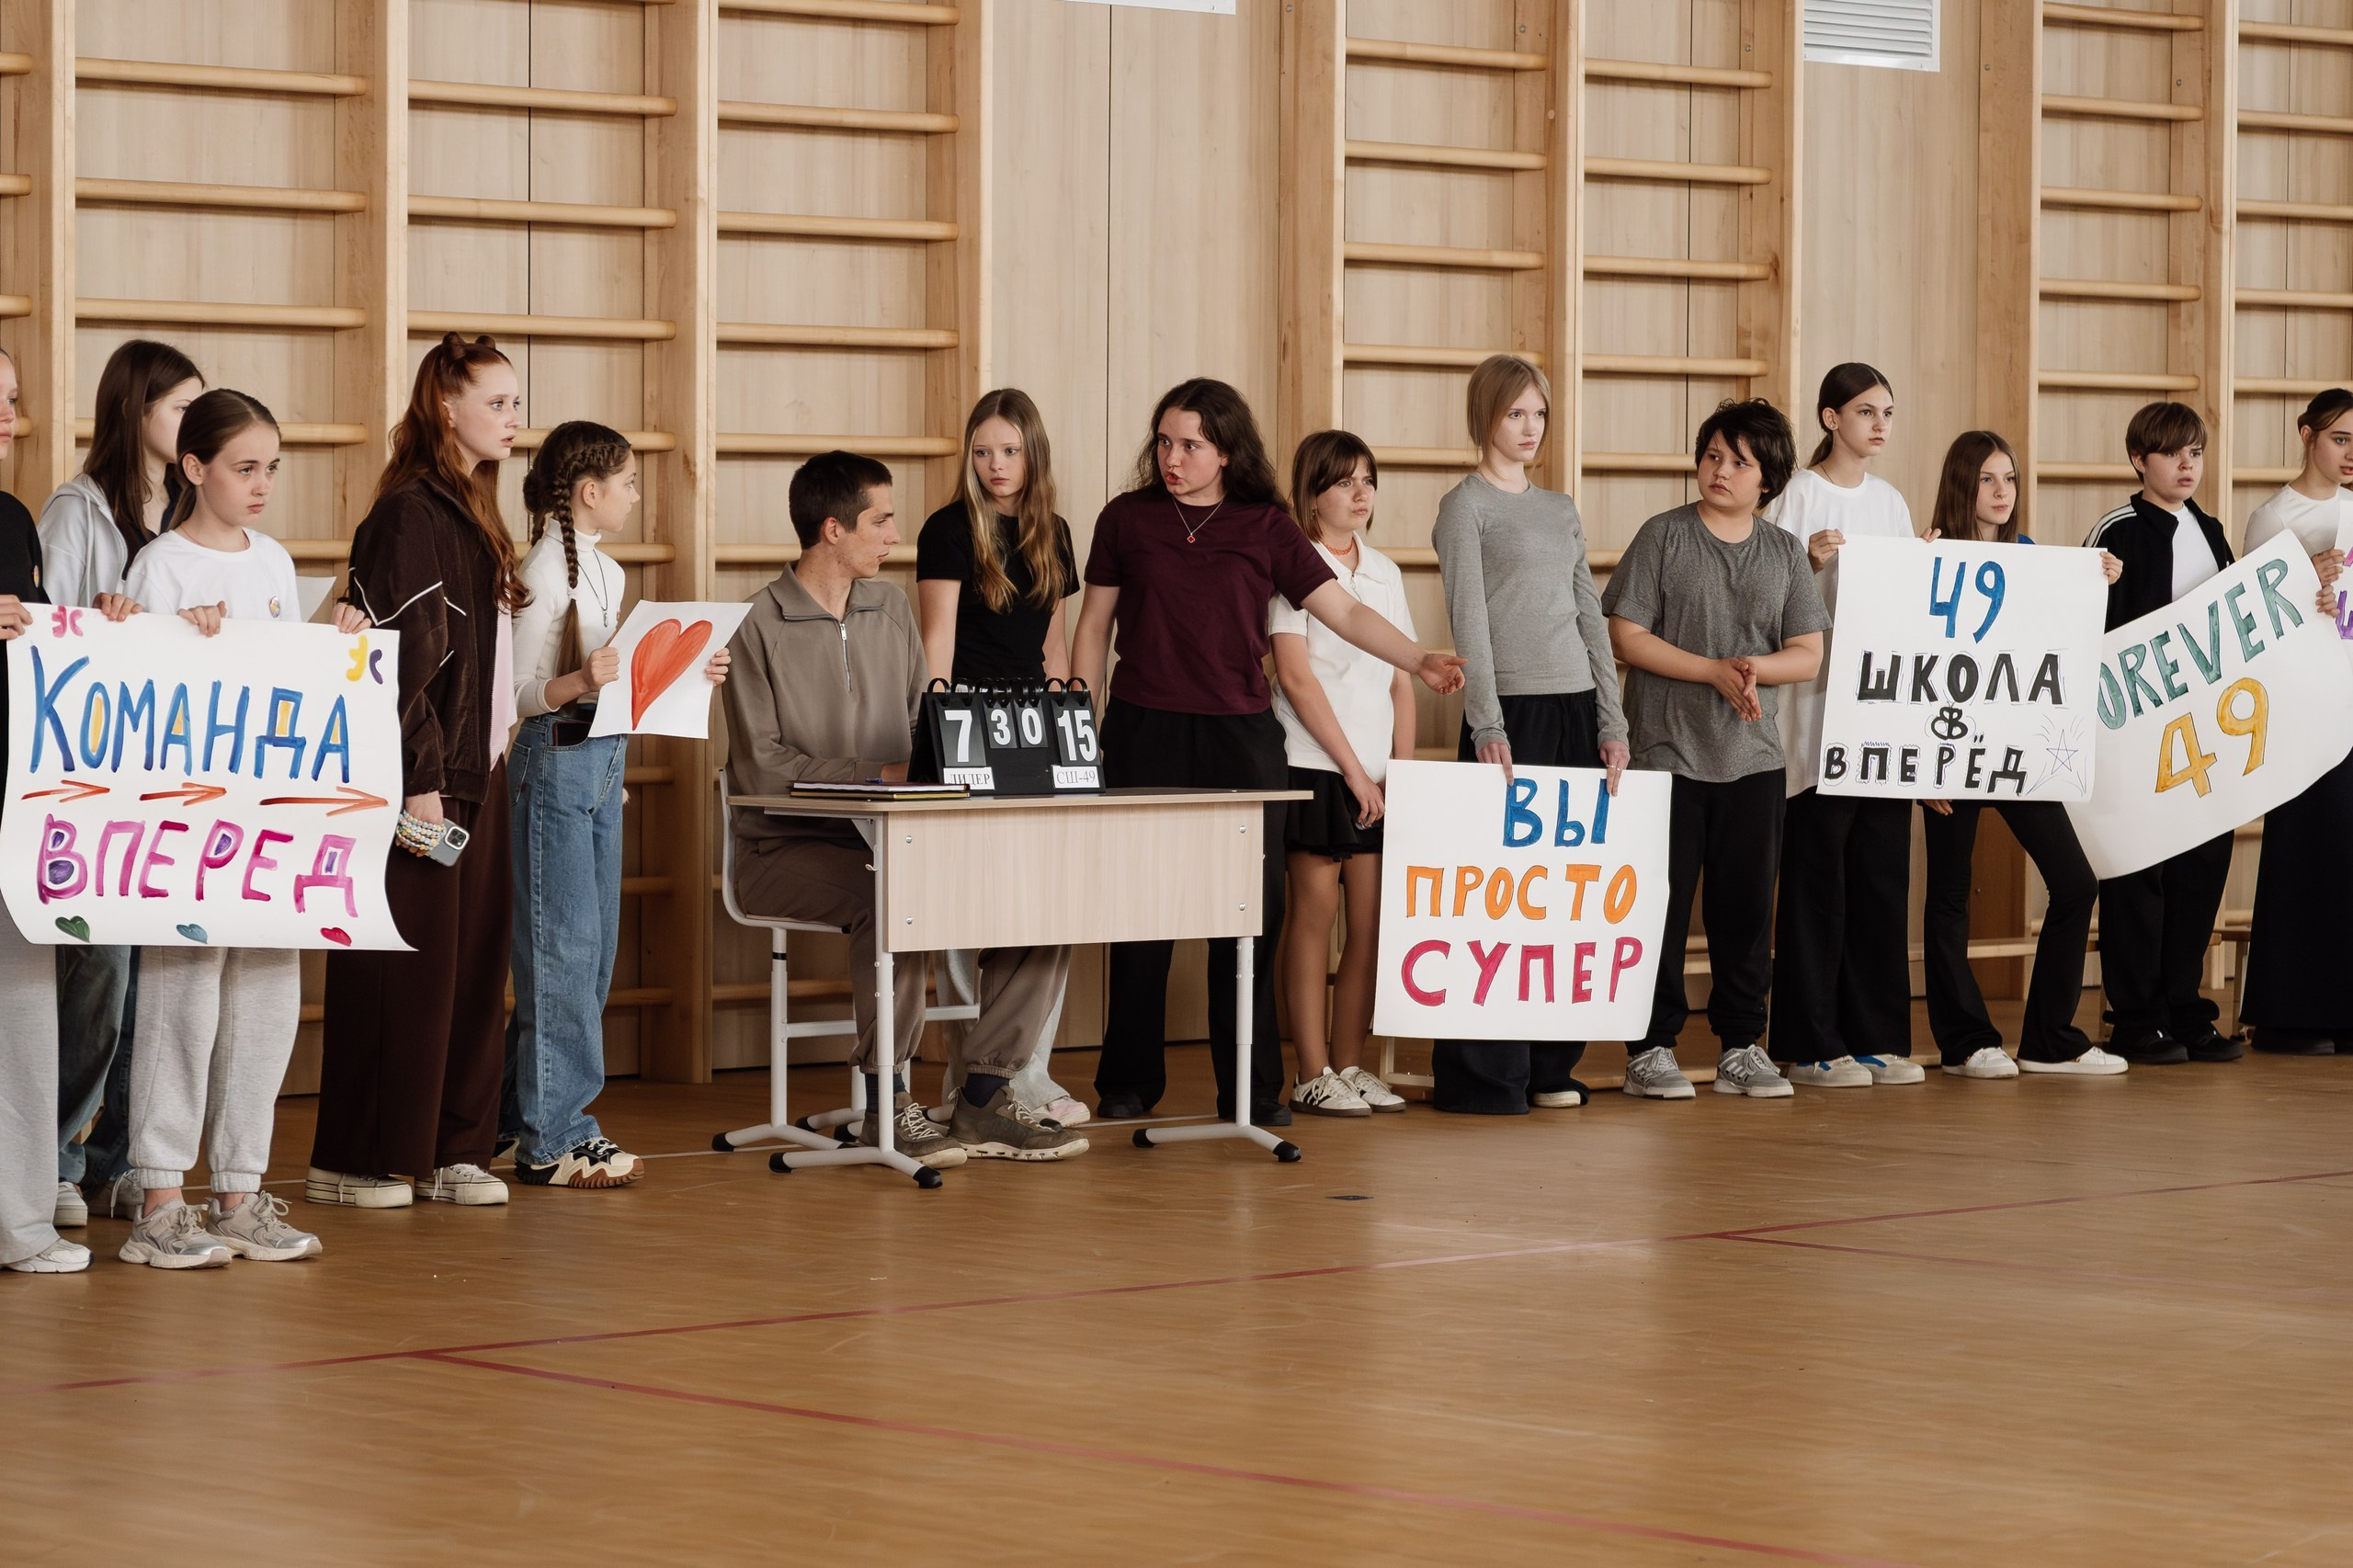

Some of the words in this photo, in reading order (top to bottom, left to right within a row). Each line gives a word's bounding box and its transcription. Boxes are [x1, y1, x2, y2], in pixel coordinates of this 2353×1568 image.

[1929, 557, 2006, 643] 49
[1856, 650, 2065, 706] ШКОЛА
[2097, 559, 2304, 730] OREVER
[29, 644, 350, 784] КОМАНДА
[944, 710, 972, 763] 7
[1057, 710, 1097, 762] 15
[2154, 677, 2269, 799] 49
[949, 773, 991, 786] ЛИДЕР
[1056, 769, 1097, 785] СШ-49
[1824, 733, 2028, 797] ВПЕРЁД
[1503, 778, 1609, 847] ВЫ
[37, 813, 358, 917] ВПЕРЕД
[1405, 863, 1638, 924] ПРОСТО
[1401, 936, 1643, 1006] СУПЕР
